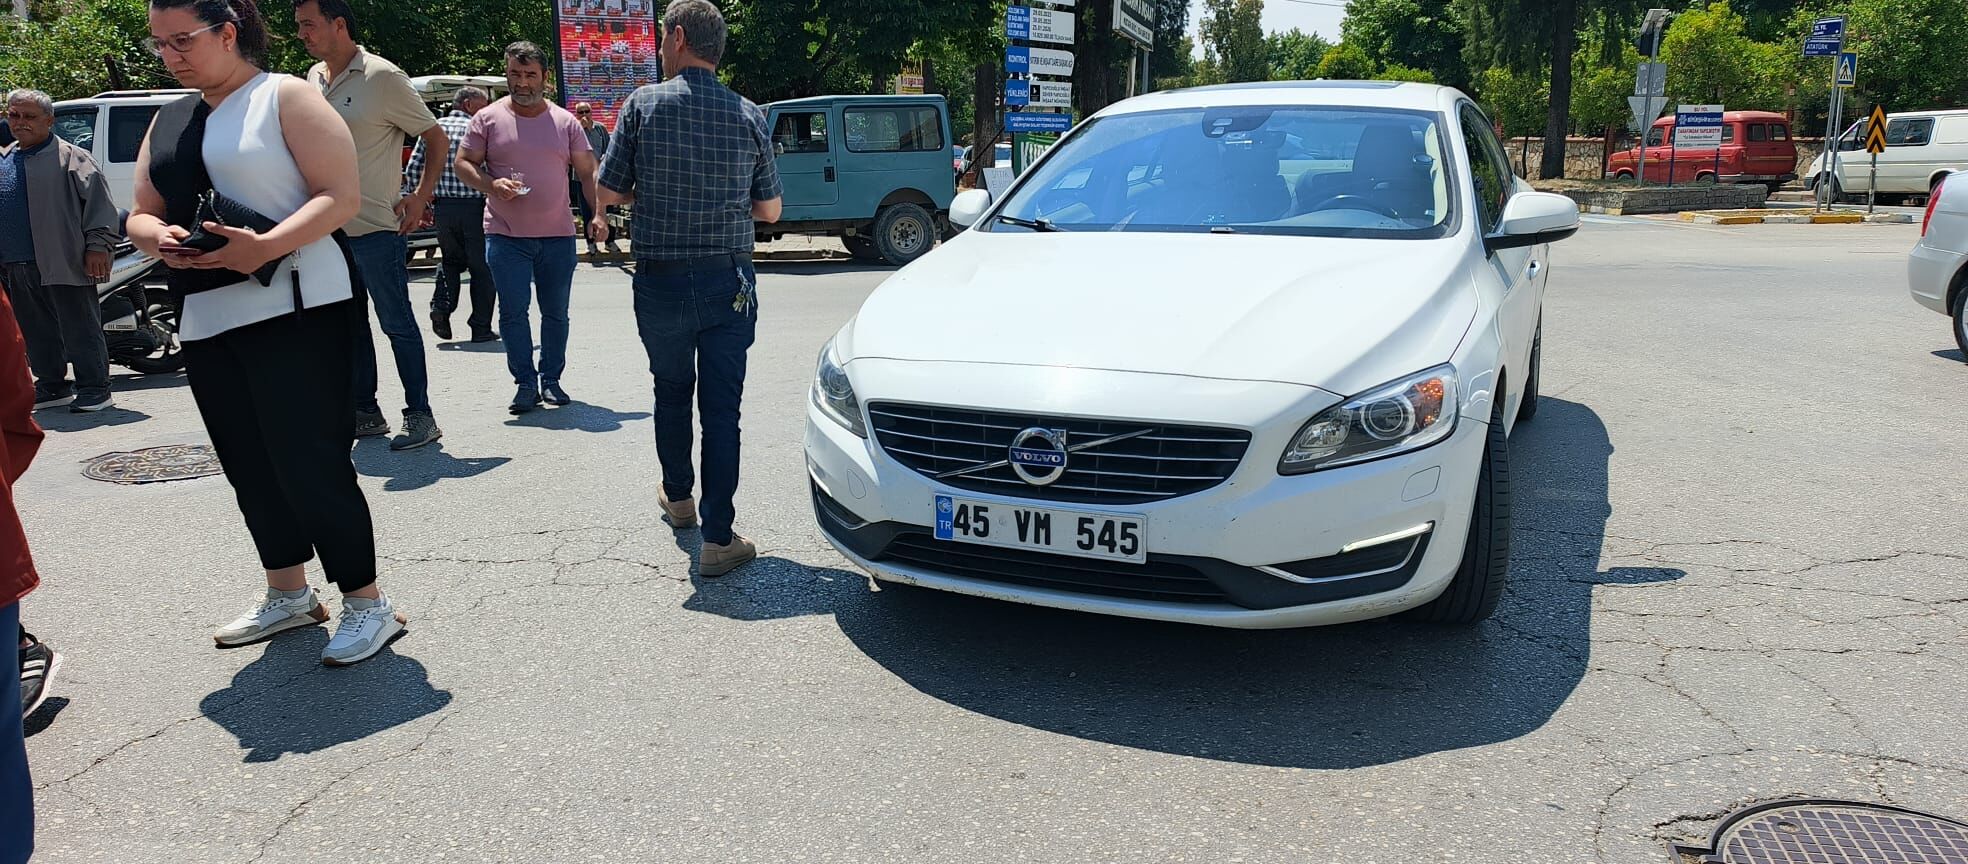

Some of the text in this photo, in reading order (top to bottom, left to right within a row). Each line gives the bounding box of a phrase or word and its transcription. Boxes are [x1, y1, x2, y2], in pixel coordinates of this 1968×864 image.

[1008, 55, 1027, 64] KONTROL
[1013, 451, 1062, 464] VOLVO
[938, 519, 952, 531] TR
[953, 503, 1139, 556] 45 VM 545
